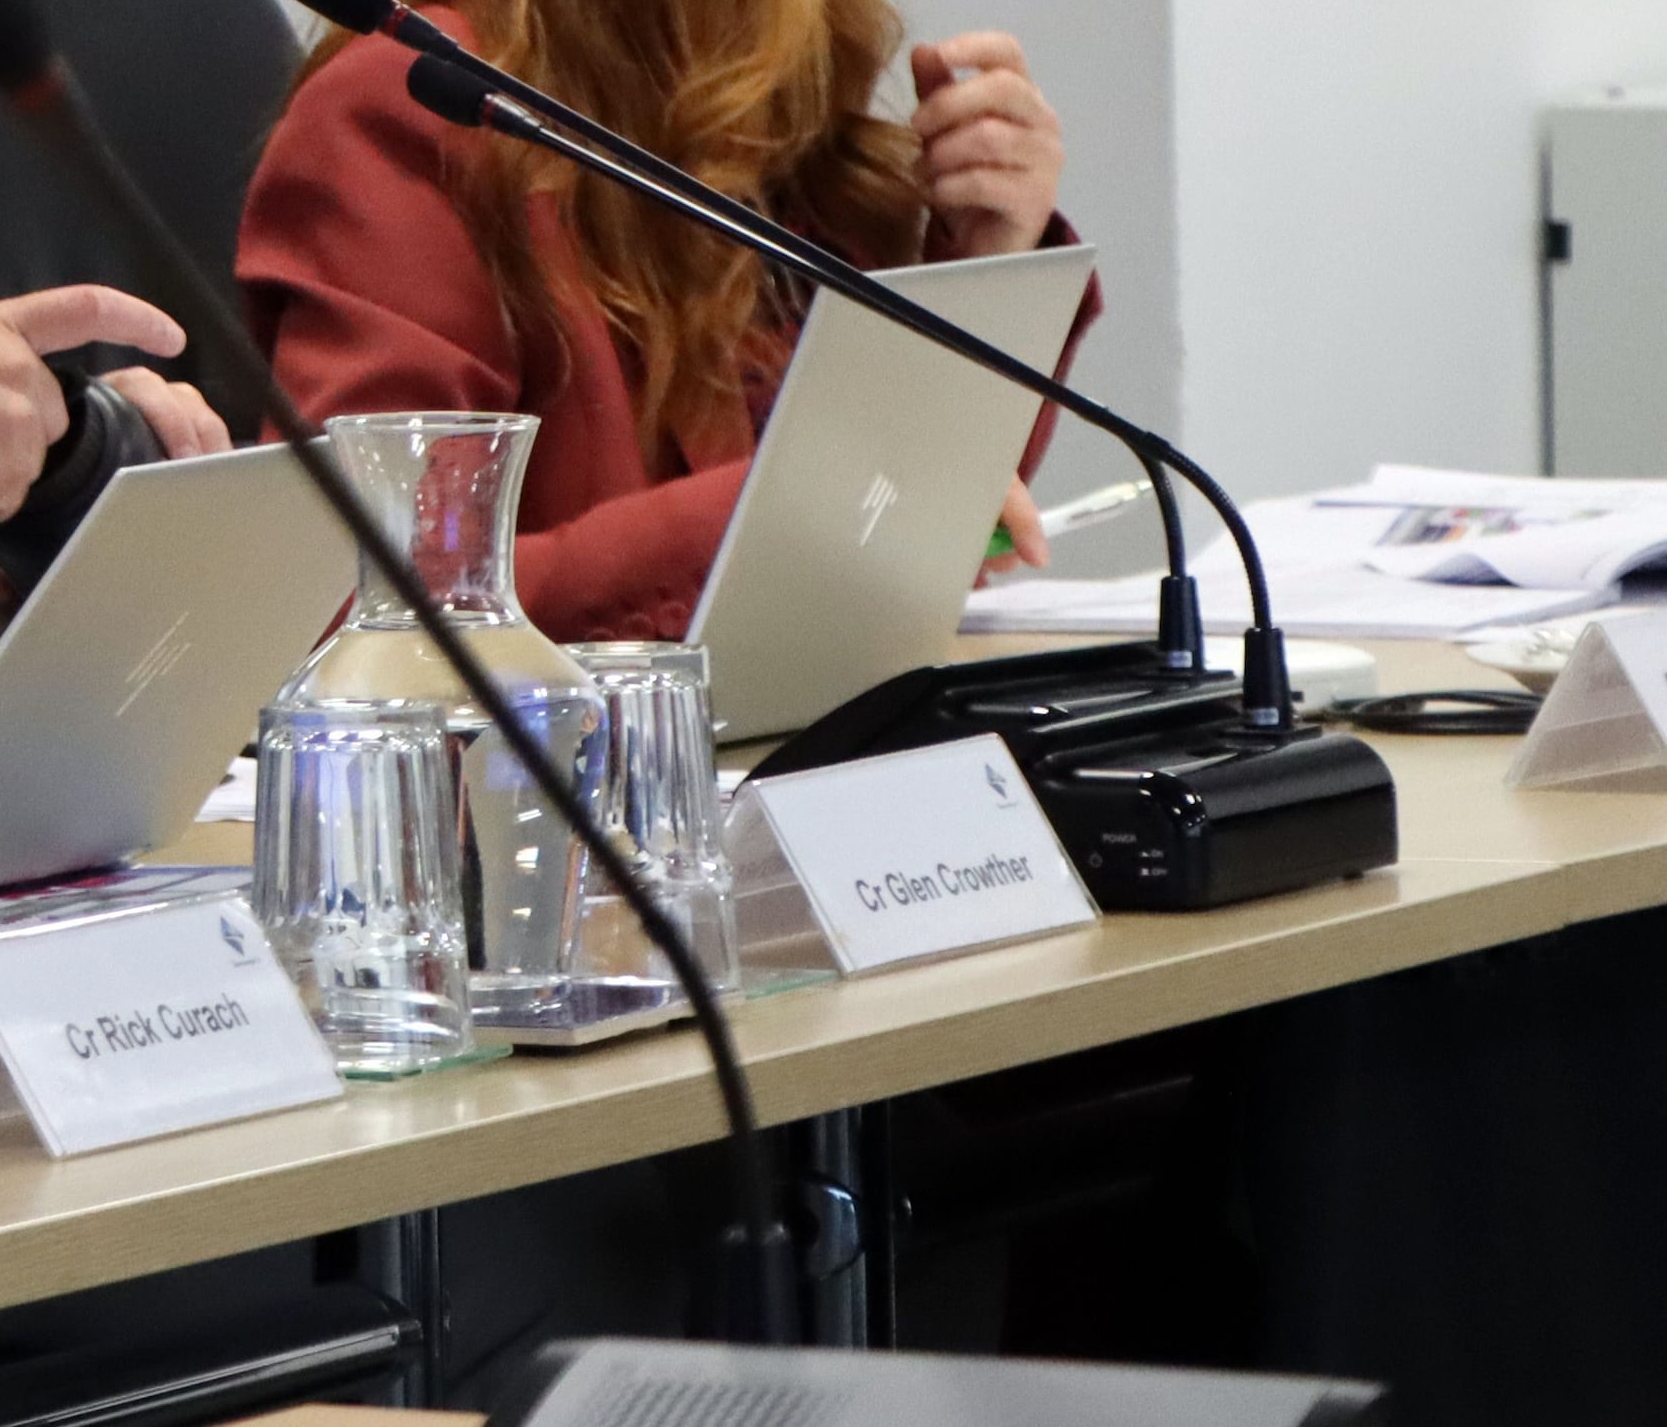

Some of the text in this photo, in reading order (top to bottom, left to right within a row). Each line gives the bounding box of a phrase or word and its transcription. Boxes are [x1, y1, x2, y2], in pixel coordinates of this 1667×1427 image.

[855, 854, 1035, 913] Cr Glen Crowther
[66, 992, 250, 1060] Cr Rick Curach
